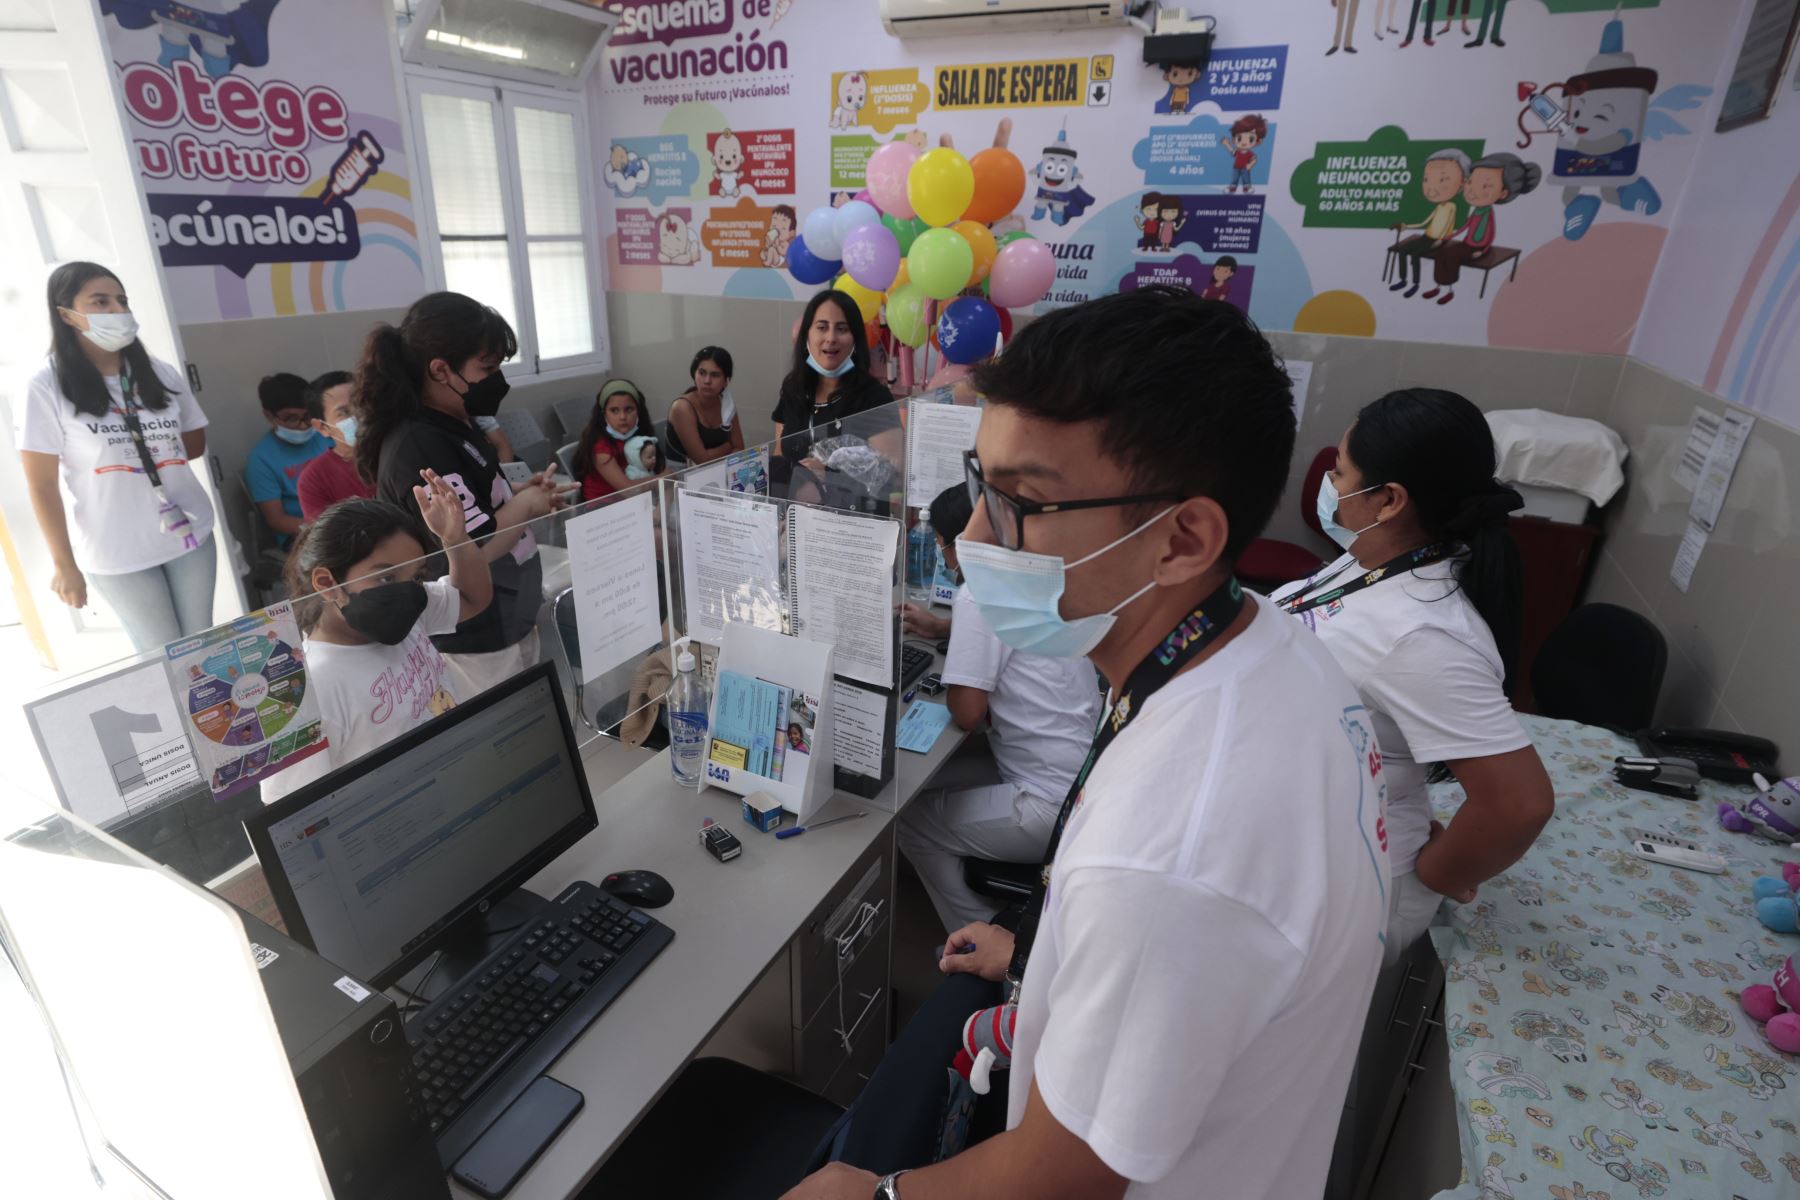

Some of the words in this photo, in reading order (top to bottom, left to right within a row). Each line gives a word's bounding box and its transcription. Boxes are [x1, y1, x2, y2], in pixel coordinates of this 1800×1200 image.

[742, 0, 771, 19] de
[610, 28, 789, 84] vacunación
[1207, 57, 1277, 71] INFLUENZA
[1209, 73, 1217, 84] 2
[1221, 74, 1230, 85] y
[1232, 72, 1239, 82] 3
[1241, 69, 1272, 82] años
[871, 83, 917, 94] INFLUENZA
[938, 68, 980, 106] SALA
[984, 66, 1007, 105] DE
[1010, 63, 1078, 104] ESPERA
[1210, 85, 1237, 95] Dosis
[1239, 84, 1268, 94] Anual
[643, 93, 680, 106] Protege
[682, 93, 694, 103] su
[695, 89, 727, 101] futuro
[729, 83, 790, 101] ¡Vacúnalos!
[123, 62, 347, 150] otege
[883, 106, 910, 114] meses
[747, 143, 792, 152] PENTAVALENTE
[138, 142, 170, 176] u
[177, 136, 307, 180] futuro
[753, 151, 786, 160] ROTAVIRUS
[1169, 166, 1177, 174] 4
[1178, 163, 1205, 174] años
[1326, 155, 1407, 170] INFLUENZA
[751, 168, 789, 177] NEUMOCOCO
[1317, 171, 1411, 185] NEUMOCOCO
[754, 179, 760, 188] 4
[761, 180, 786, 188] meses
[1320, 188, 1362, 198] ADULTO
[1364, 188, 1404, 199] MAYOR
[1319, 201, 1333, 211] 60
[1334, 198, 1364, 211] AÑOS
[1365, 201, 1373, 211] A
[1375, 198, 1400, 211] MÁS
[152, 200, 347, 246] acúnalos!
[1234, 226, 1251, 234] años
[1056, 265, 1088, 280] vida
[1153, 268, 1178, 277] TDAP
[1137, 275, 1184, 285] HEPATITIS
[86, 417, 178, 434] Vacuación
[108, 436, 134, 446] para
[144, 433, 170, 442] odos
[163, 744, 185, 757] DOSIS
[170, 763, 191, 776] DOSIS
[144, 772, 169, 787] ANUAL
